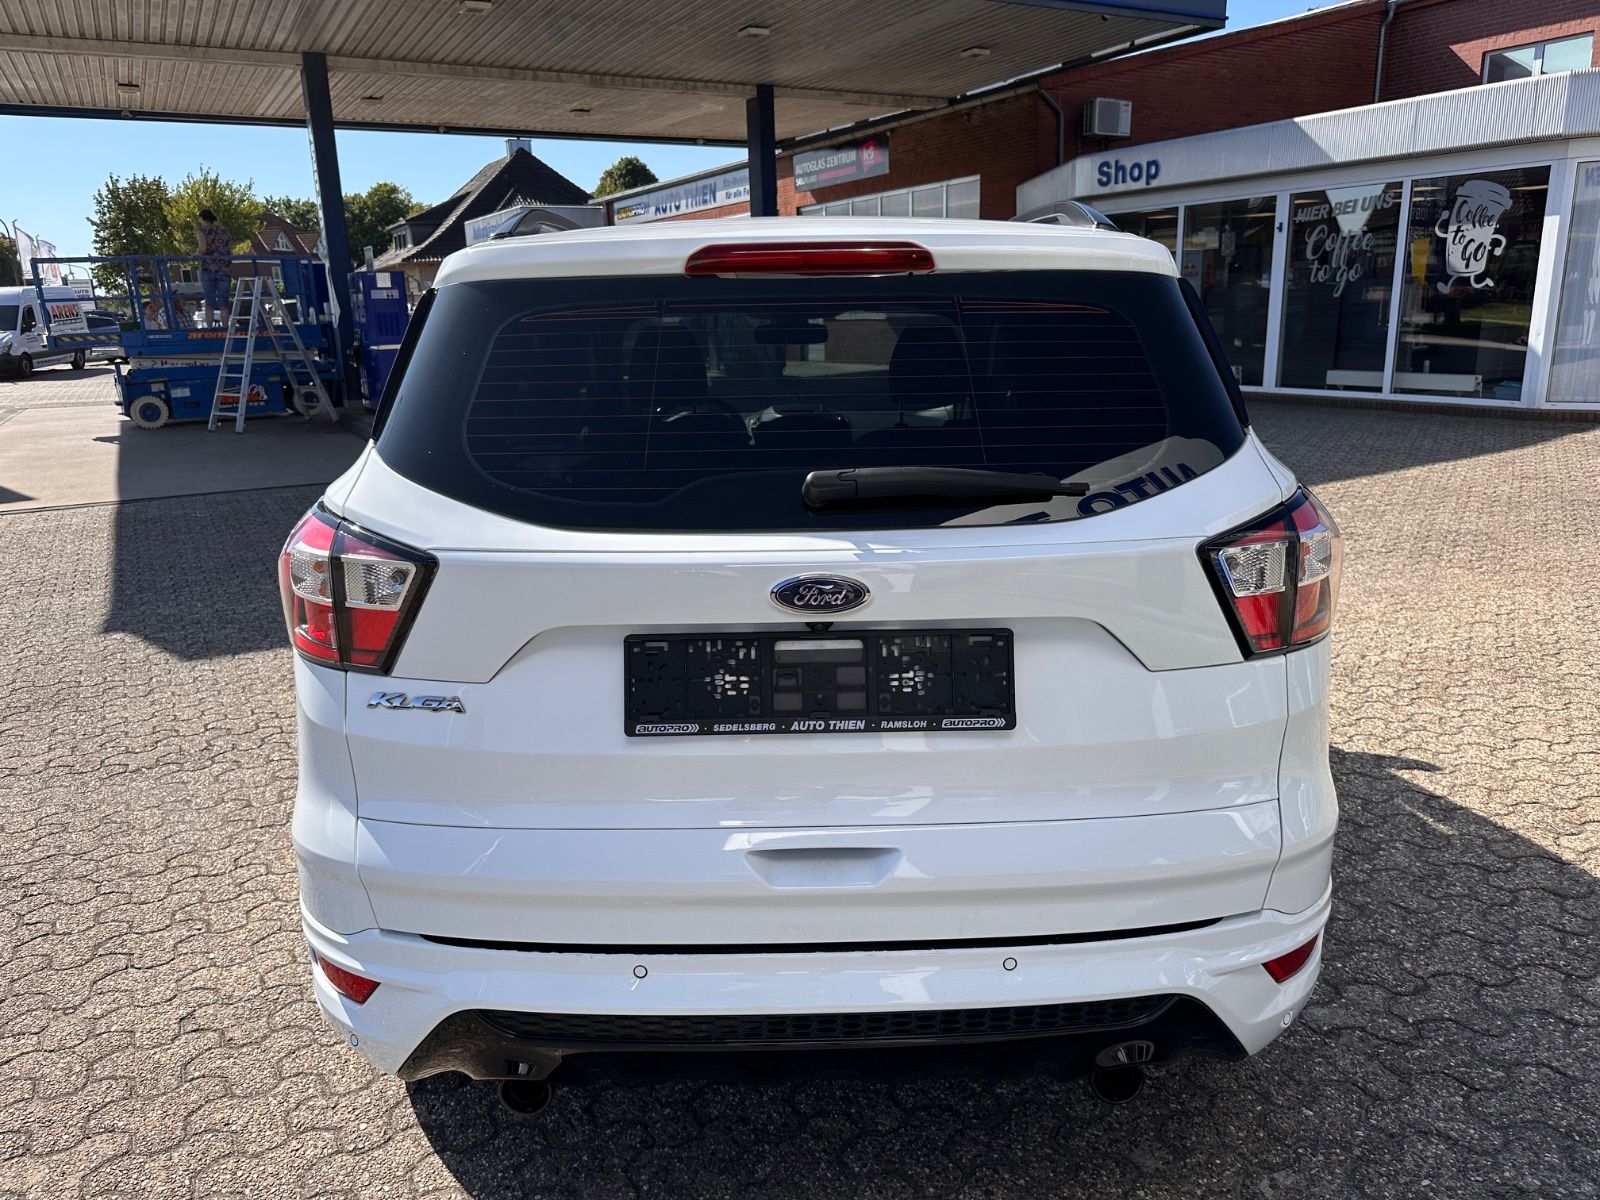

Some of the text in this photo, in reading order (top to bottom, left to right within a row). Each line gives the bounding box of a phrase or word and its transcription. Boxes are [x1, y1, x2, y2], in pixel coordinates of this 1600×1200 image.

[795, 150, 857, 175] AUTOGLAS ZENTRUM
[1097, 159, 1160, 187] Shop
[654, 190, 681, 216] AUTO
[683, 182, 717, 210] THIEN
[1296, 204, 1330, 223] HIER
[1332, 199, 1357, 217] BEI
[1361, 192, 1395, 214] UNS
[1456, 200, 1496, 229] Coffee
[1305, 224, 1374, 268] Coffee
[1450, 225, 1467, 246] to
[1309, 260, 1362, 298] to go
[793, 583, 848, 606] Ford
[366, 691, 466, 714] KUGA
[713, 723, 776, 732] SEDELSBERG
[790, 720, 825, 731] AUTO
[829, 719, 865, 730] THIEN
[880, 719, 928, 729] RAMSLOH
